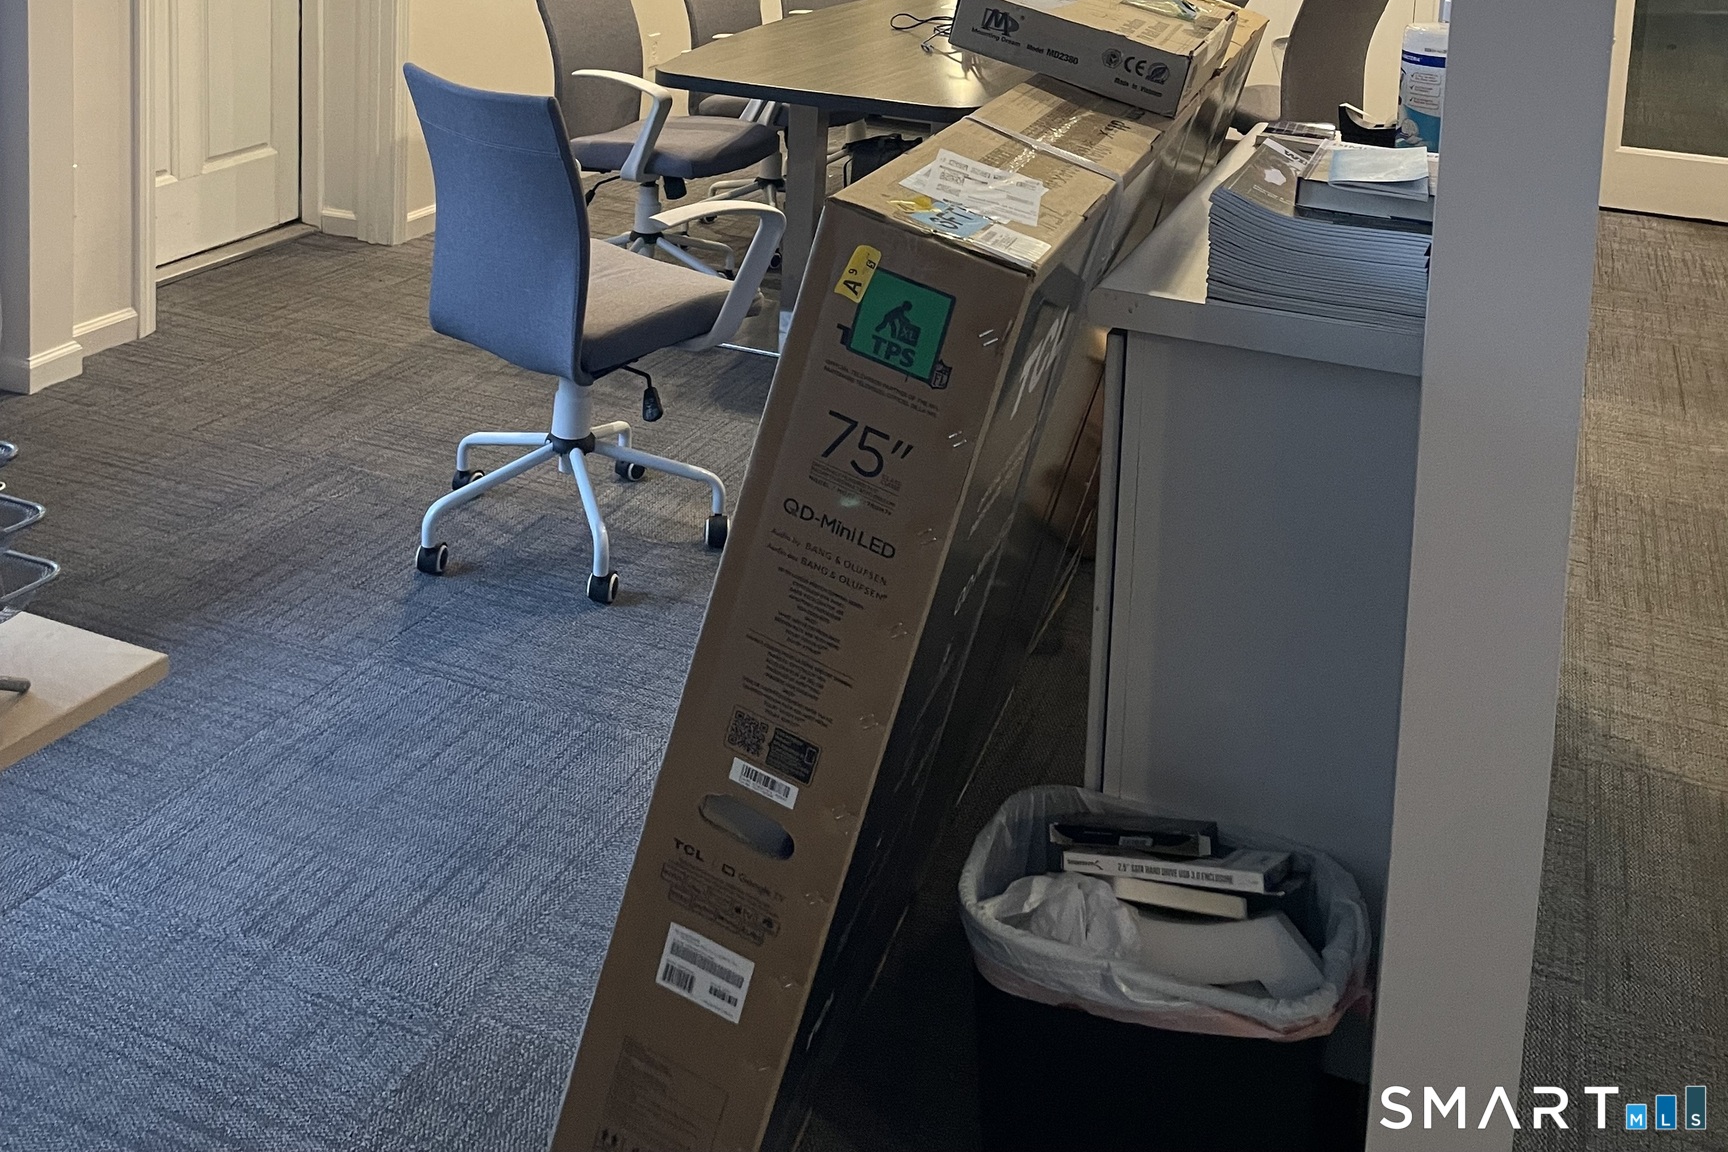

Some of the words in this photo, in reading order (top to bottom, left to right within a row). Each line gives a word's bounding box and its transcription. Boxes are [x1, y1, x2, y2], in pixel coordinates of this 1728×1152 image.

[843, 279, 862, 296] A
[872, 333, 916, 368] TPS
[801, 556, 828, 576] BANG
[805, 542, 832, 561] BANG
[843, 560, 887, 586] OLUFSEN
[674, 837, 704, 862] TCL
